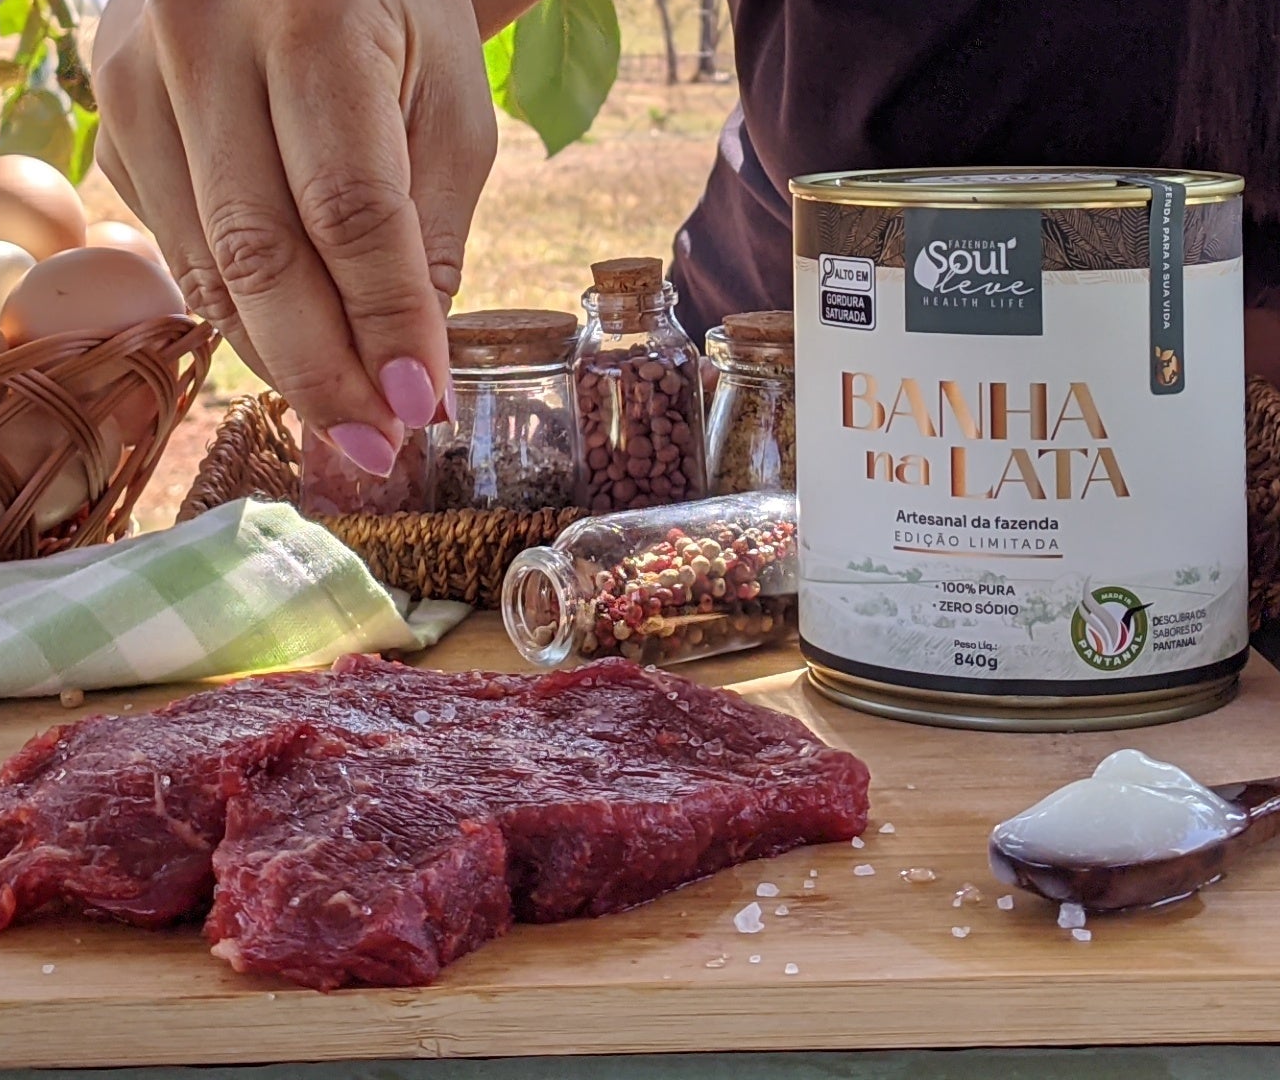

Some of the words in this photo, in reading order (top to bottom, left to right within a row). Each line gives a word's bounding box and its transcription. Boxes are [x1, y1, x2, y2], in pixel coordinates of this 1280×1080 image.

[948, 239, 996, 250] FAZENDA
[1162, 227, 1170, 260] PARA
[928, 240, 1011, 275] Soul
[1162, 263, 1170, 271] A
[834, 270, 854, 281] ALTO
[856, 271, 869, 283] EM
[935, 263, 1034, 296] leve
[1162, 273, 1170, 298] SUA
[826, 293, 865, 309] GORDURA
[923, 297, 978, 308] HEALTH
[990, 298, 1025, 309] LIFE
[825, 307, 867, 323] SATURADA
[1162, 300, 1171, 330] VIDA
[841, 371, 1109, 441] BANHA
[866, 450, 930, 486] na
[950, 446, 1131, 500] LATA
[896, 509, 967, 528] Artesanal
[971, 516, 991, 530] da
[991, 516, 1059, 530] fazenda
[894, 530, 960, 547] EDIÇÃO
[969, 536, 1059, 550] LIMITADA
[941, 582, 976, 595] 100%
[978, 584, 1016, 596] PURA
[1101, 592, 1123, 601] MADE
[939, 601, 972, 614] ZERO
[975, 600, 1019, 616] SÓDIO
[1152, 611, 1195, 627] DESCUBRA
[1195, 608, 1207, 620] OS
[1153, 626, 1191, 639] SABORES
[1190, 622, 1203, 634] DO
[953, 639, 977, 650] Peso
[1078, 634, 1143, 667] PANTANAL
[1153, 636, 1197, 652] PANTANAL
[954, 653, 998, 671] 840g
